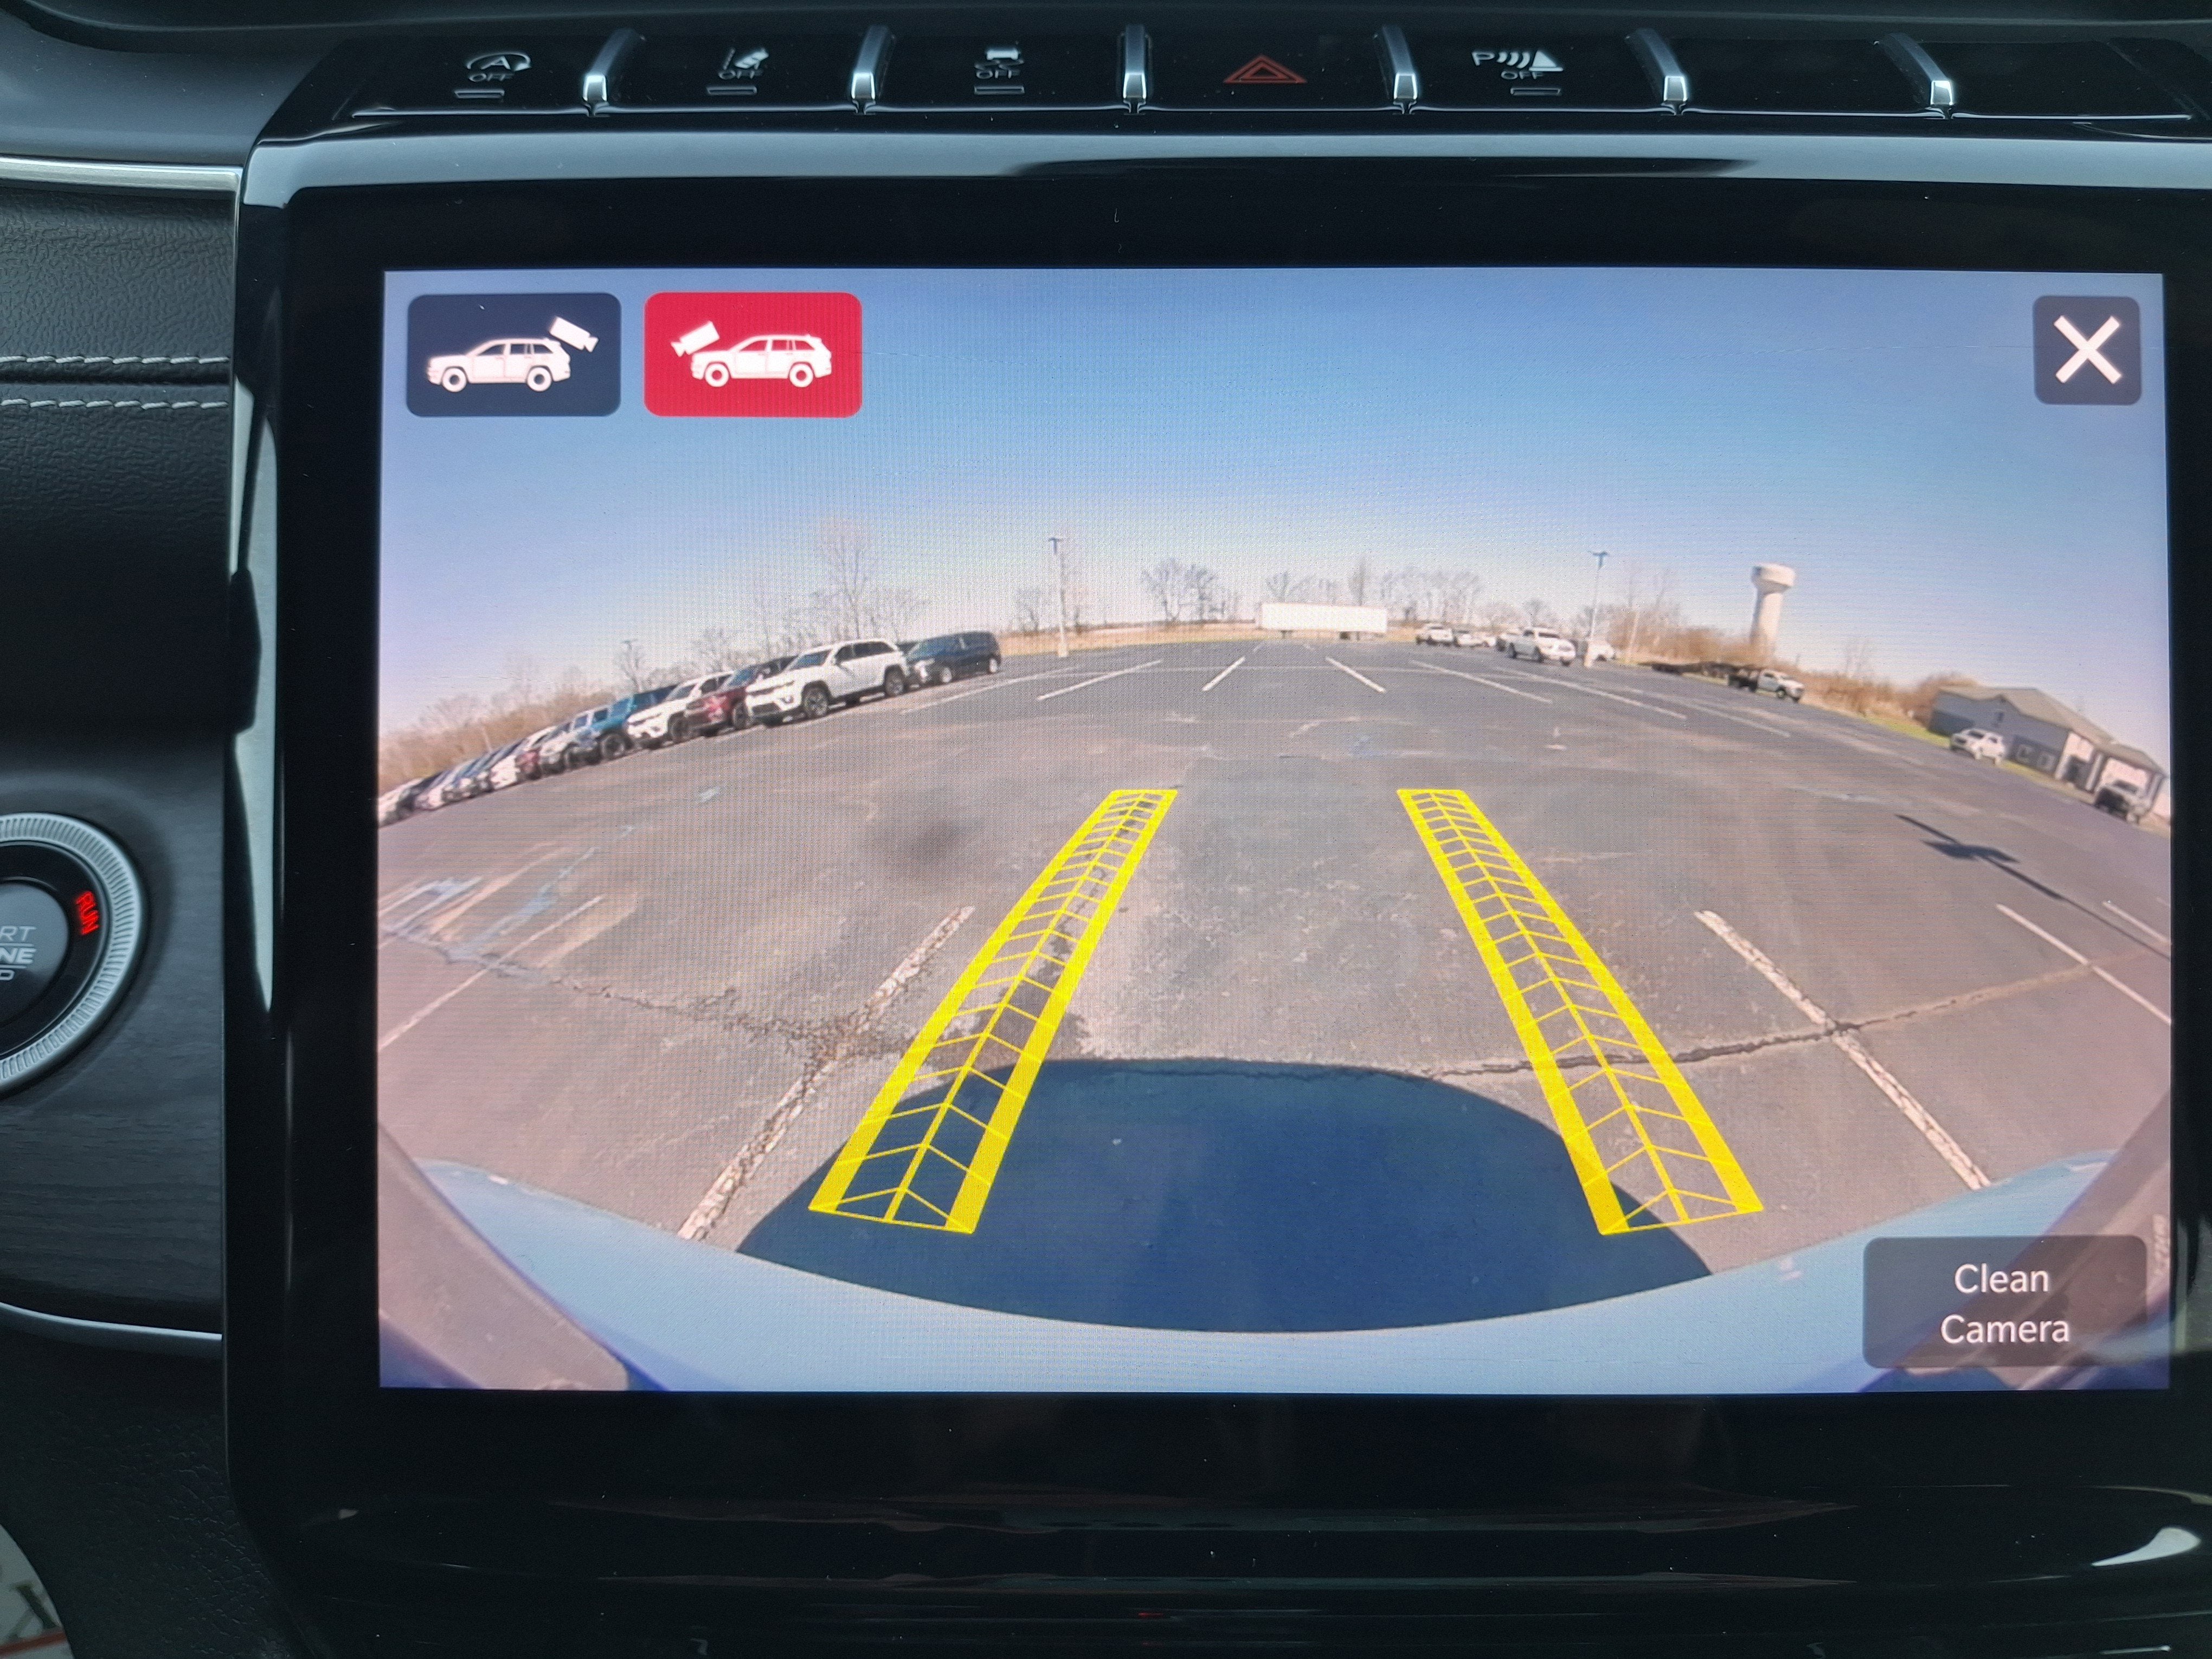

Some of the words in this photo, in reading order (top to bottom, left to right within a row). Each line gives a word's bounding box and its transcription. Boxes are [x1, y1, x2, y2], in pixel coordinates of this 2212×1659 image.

[1501, 70, 1544, 80] OFF
[76, 891, 100, 935] RUN
[1954, 1263, 2049, 1294] Clean
[1940, 1314, 2070, 1343] Camera
